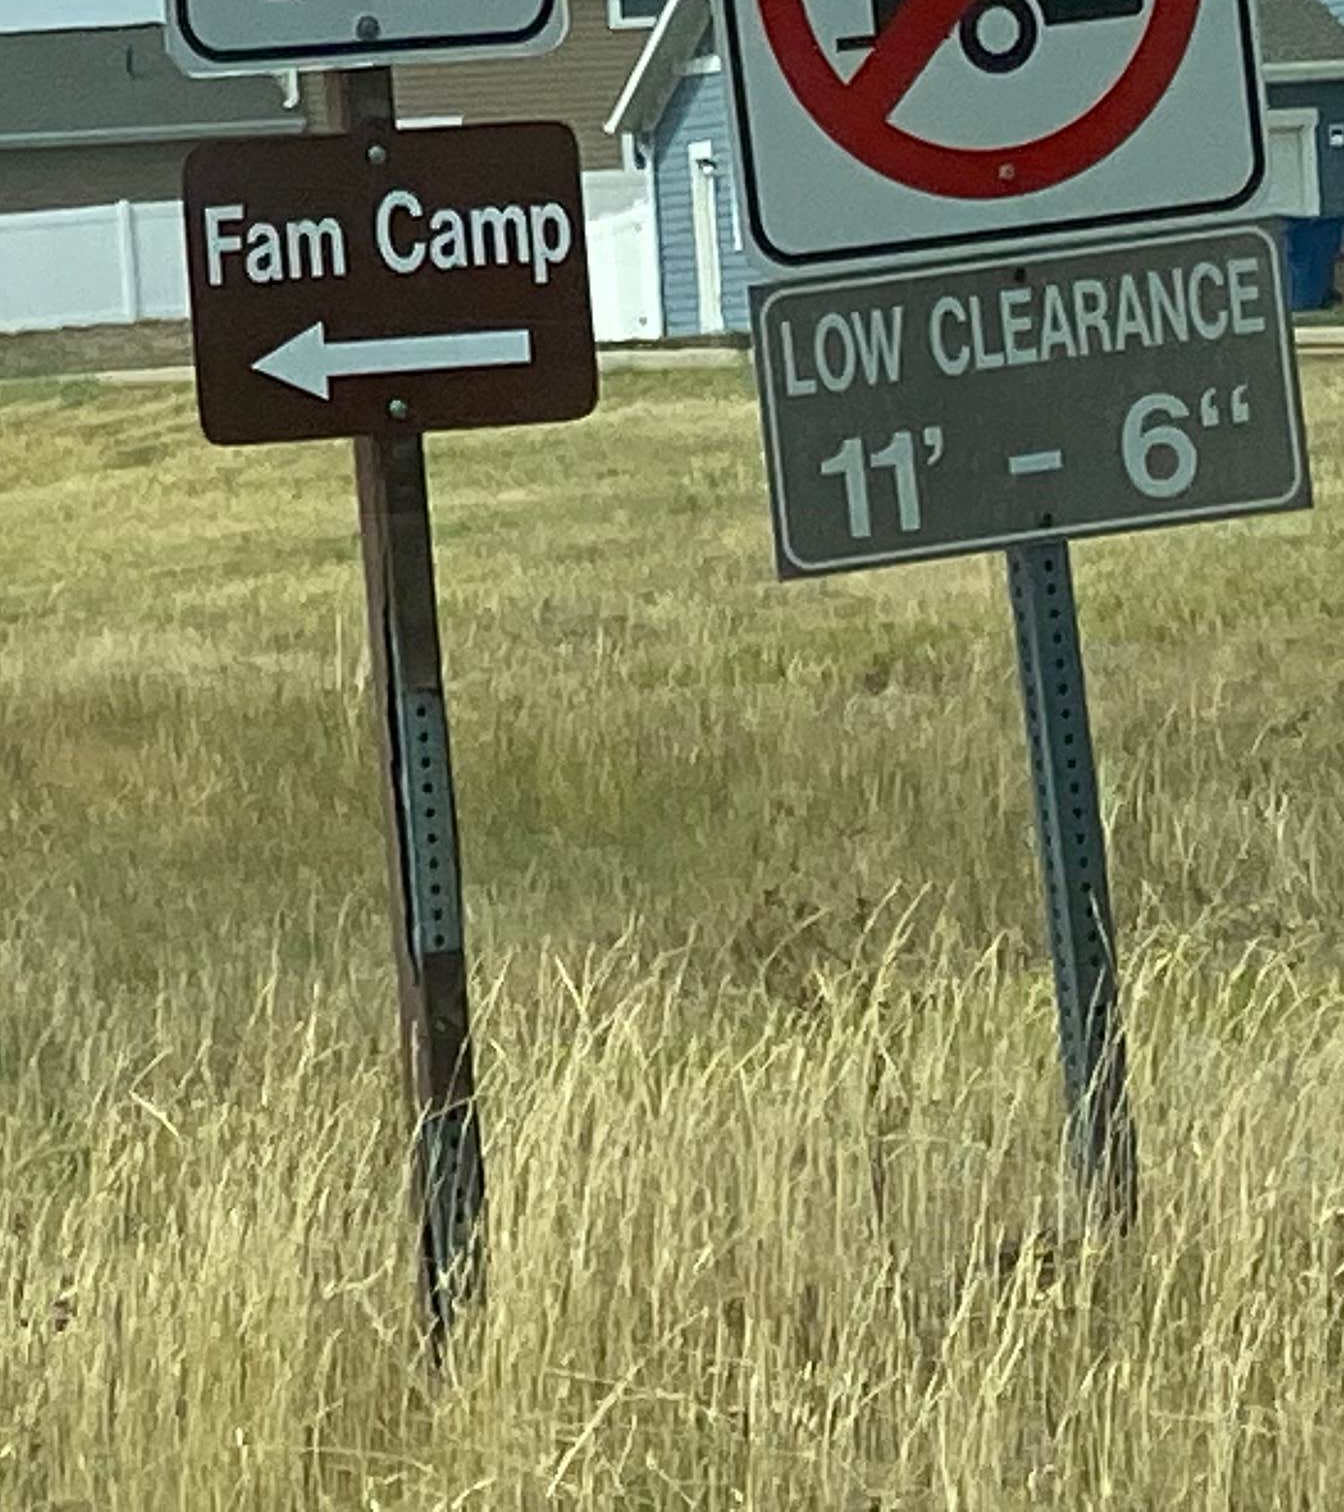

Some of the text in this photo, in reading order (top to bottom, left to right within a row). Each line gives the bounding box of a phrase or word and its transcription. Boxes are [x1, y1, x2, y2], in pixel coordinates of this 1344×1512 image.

[205, 191, 573, 288] Fam Camp
[780, 257, 1265, 397] LOW CLEARANCE
